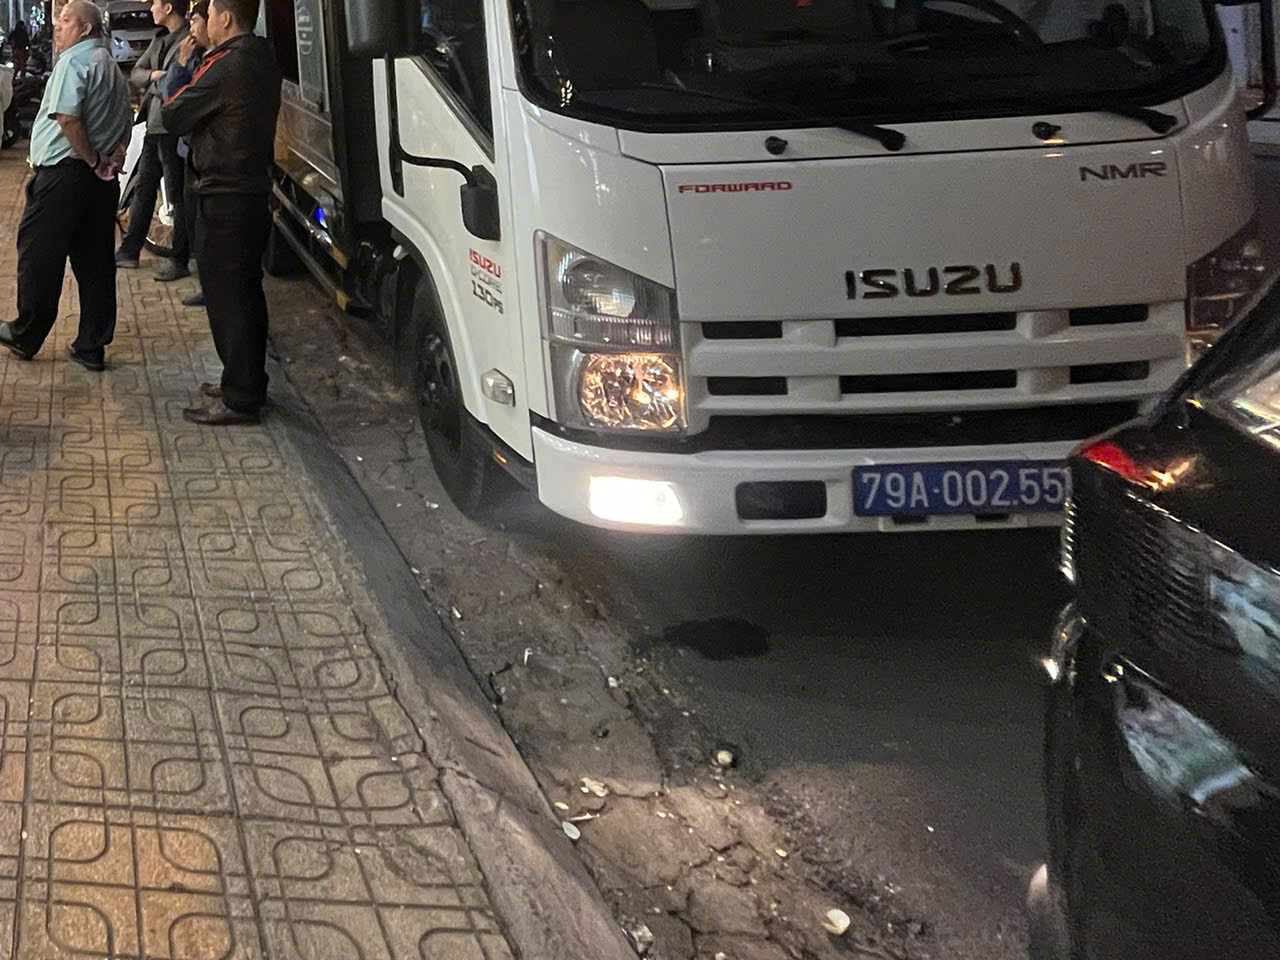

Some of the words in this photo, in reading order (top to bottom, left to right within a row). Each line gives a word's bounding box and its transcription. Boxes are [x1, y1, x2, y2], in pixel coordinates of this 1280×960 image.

[678, 181, 793, 194] FORWARD
[1079, 161, 1168, 182] NMR
[469, 247, 502, 279] ISUZU
[845, 261, 1022, 300] ISUZU
[861, 468, 1065, 509] 79A-002.55
